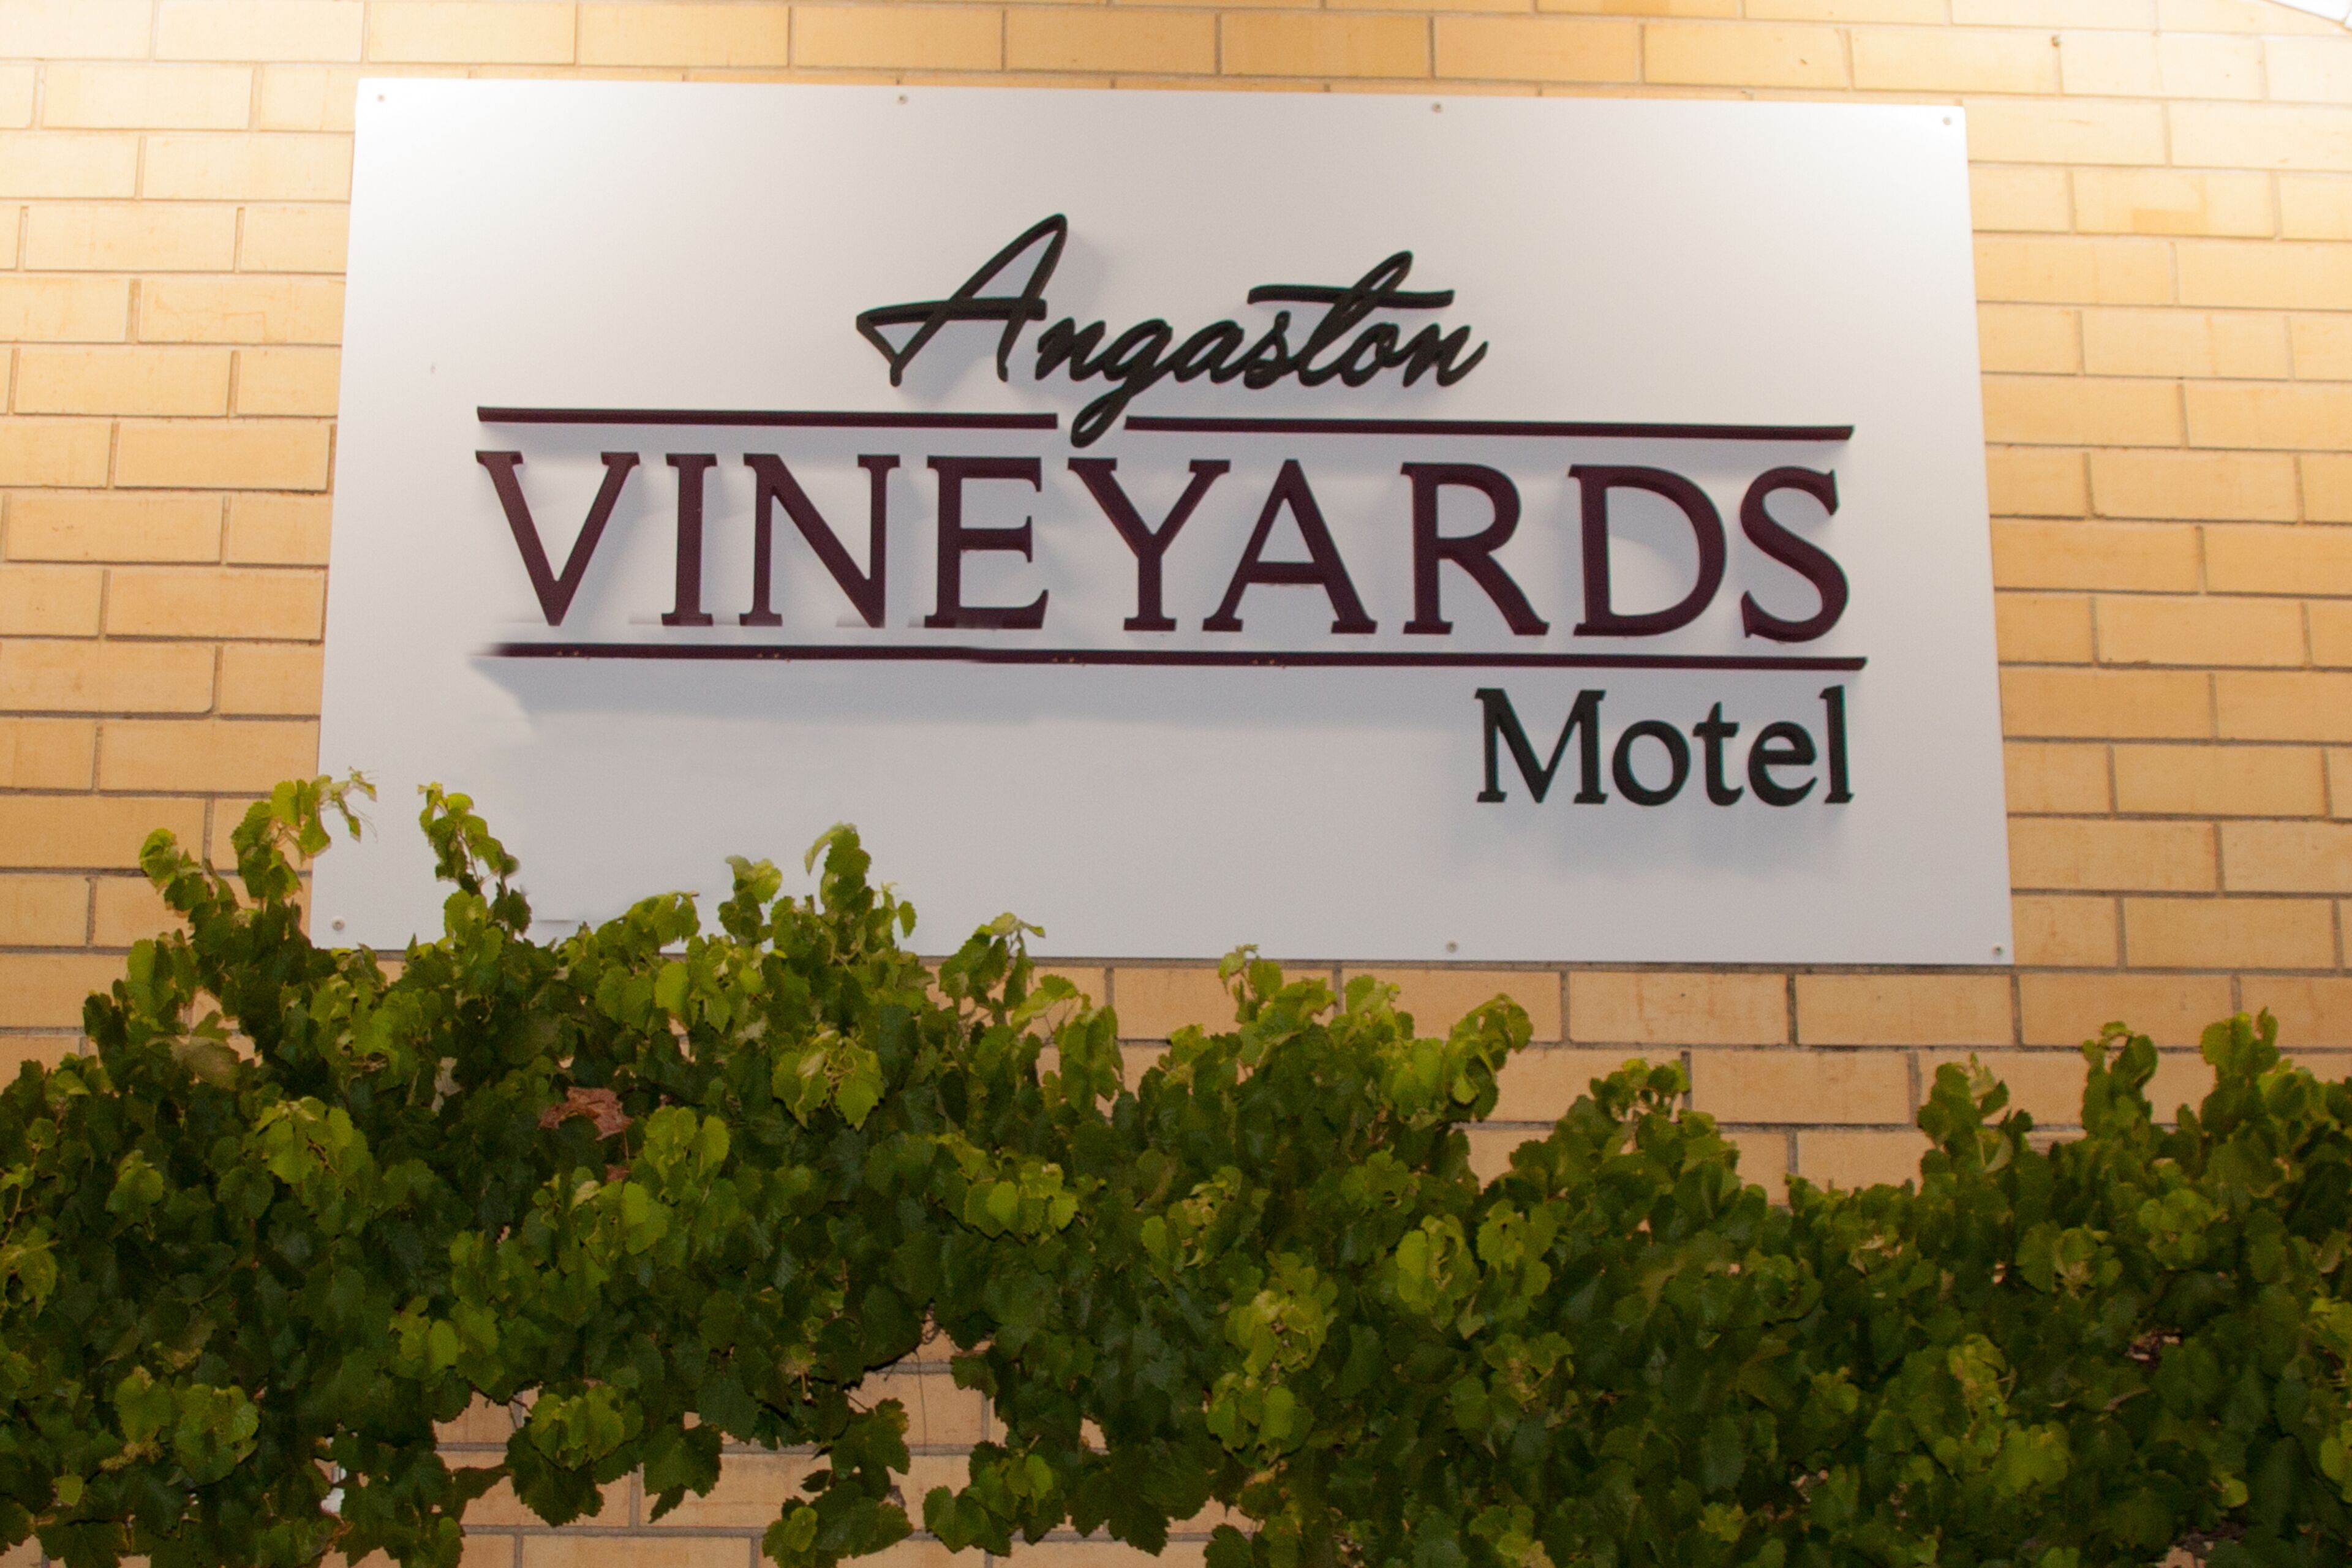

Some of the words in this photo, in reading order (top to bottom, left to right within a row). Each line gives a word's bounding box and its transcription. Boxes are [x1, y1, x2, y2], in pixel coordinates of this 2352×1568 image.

[856, 213, 1488, 449] Angaston
[475, 450, 1850, 643] VINEYARDS
[1474, 684, 1853, 809] Motel
